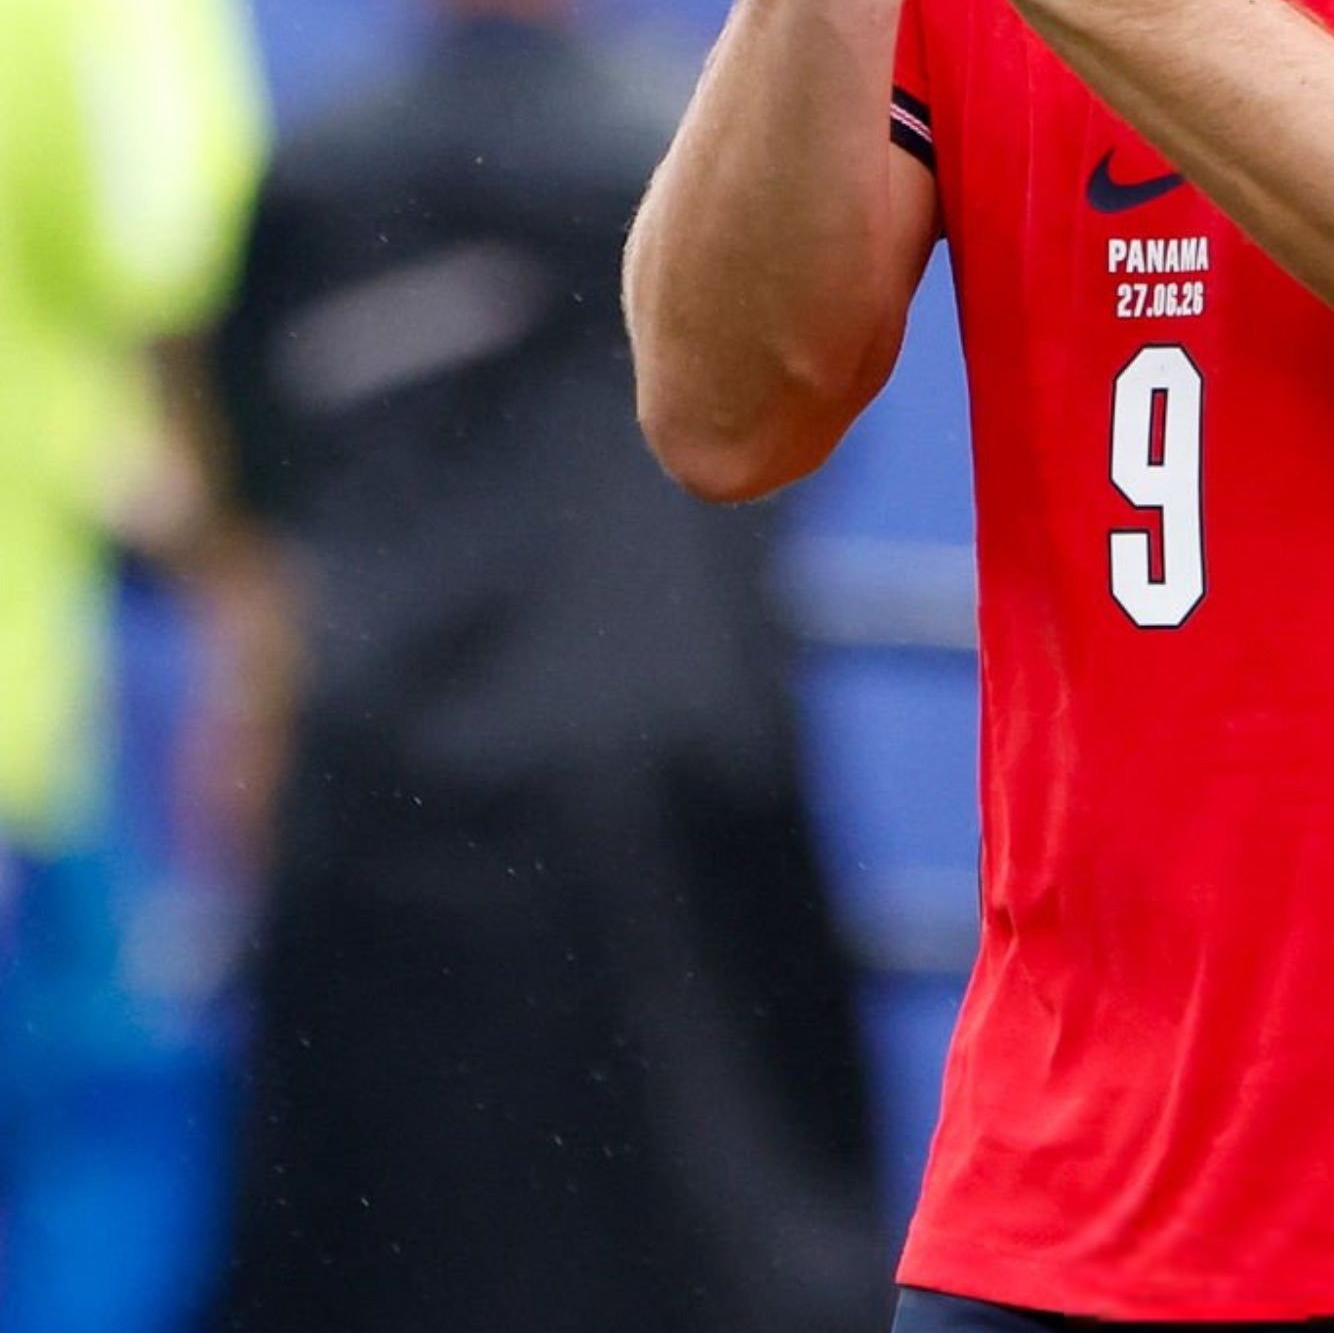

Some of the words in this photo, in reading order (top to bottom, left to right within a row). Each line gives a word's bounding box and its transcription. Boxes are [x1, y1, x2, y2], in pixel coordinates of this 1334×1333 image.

[1108, 237, 1208, 273] PANAMA
[1117, 281, 1204, 318] 27.06.26
[1109, 344, 1206, 628] 9
